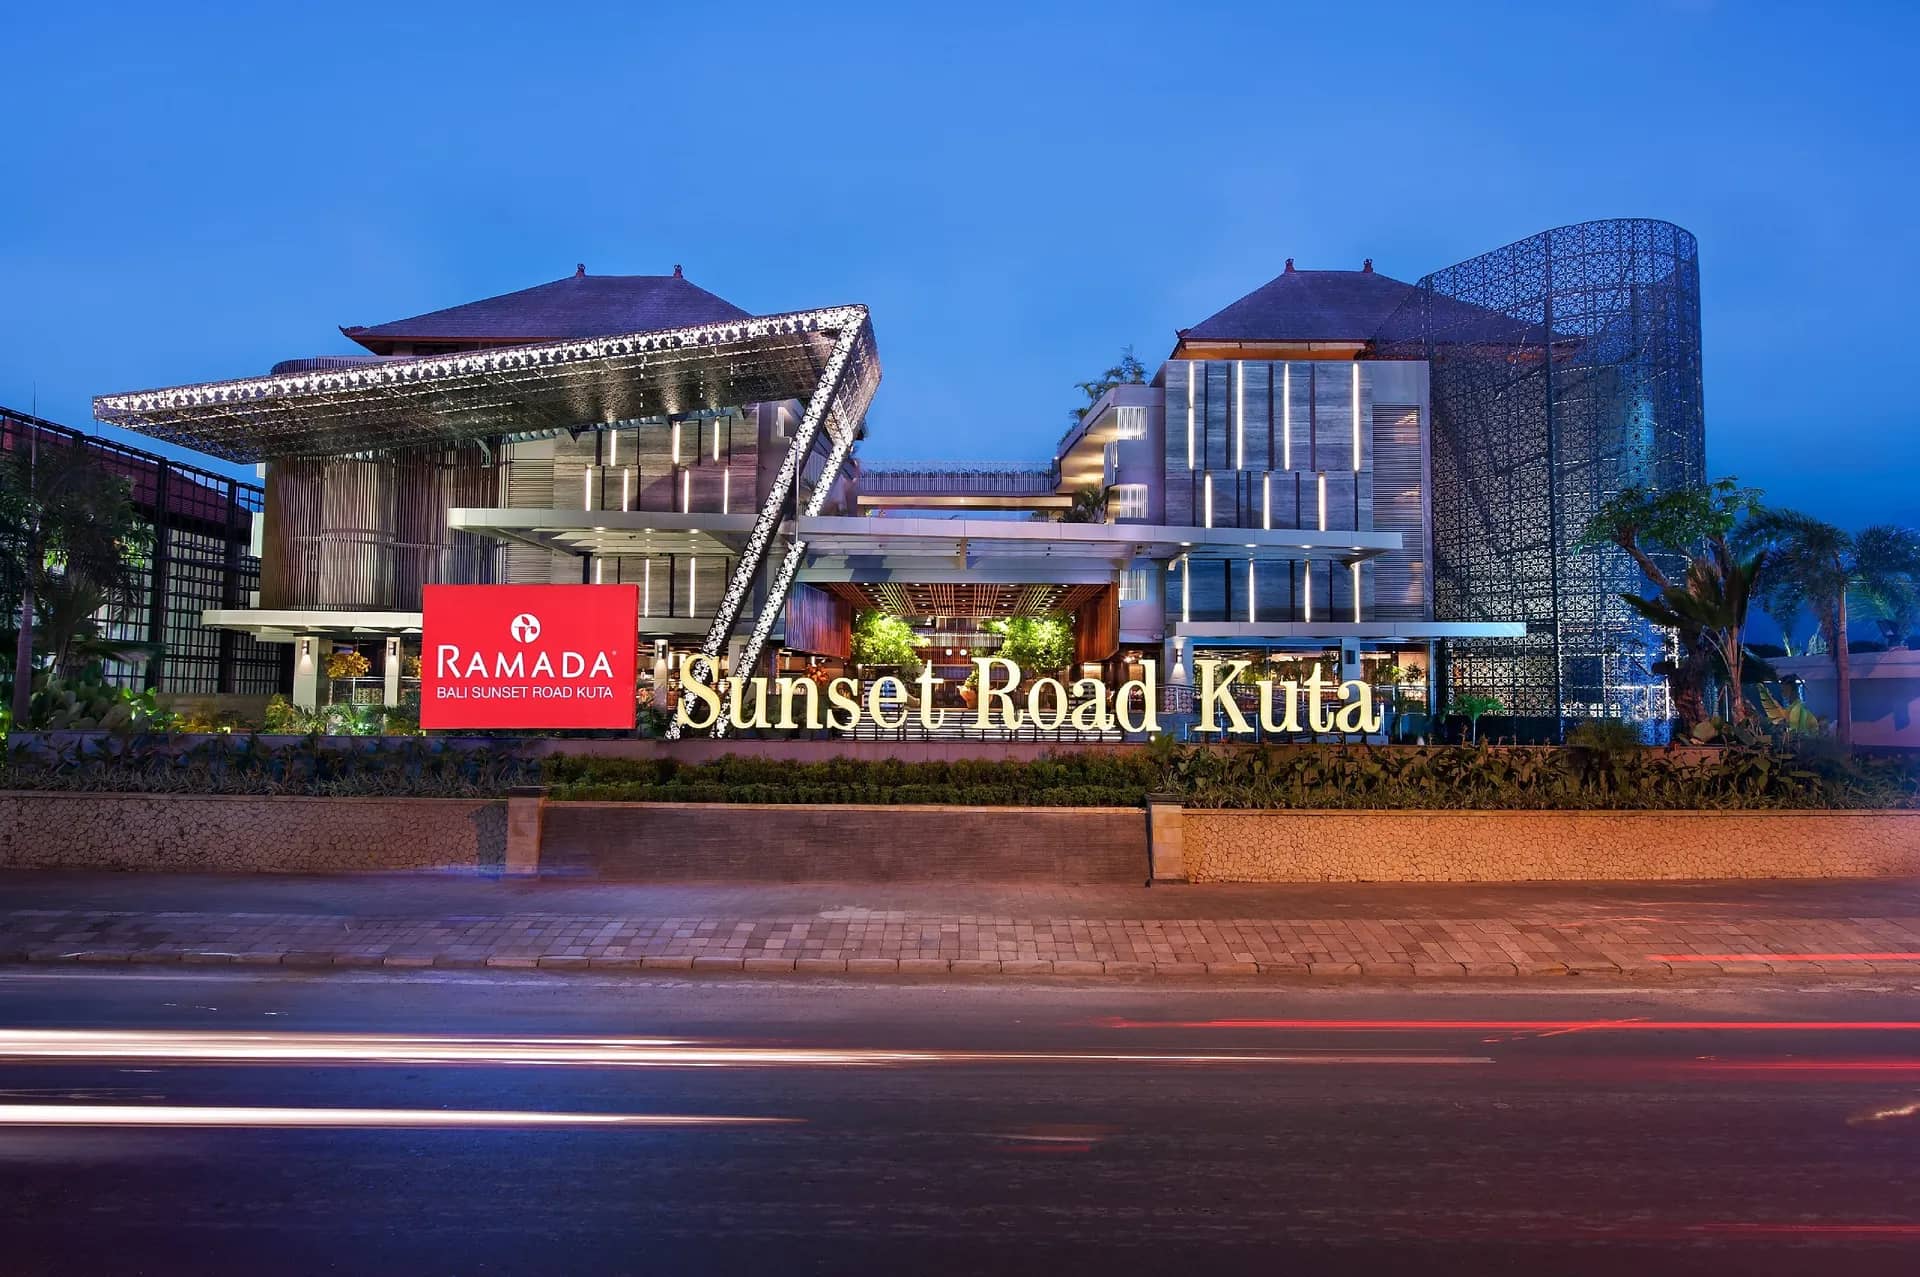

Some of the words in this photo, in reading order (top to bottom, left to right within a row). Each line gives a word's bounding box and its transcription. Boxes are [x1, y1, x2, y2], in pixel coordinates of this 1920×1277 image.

[436, 686, 468, 699] BALI
[471, 686, 529, 699] SUNSET
[532, 686, 573, 699] ROAD
[577, 686, 614, 699] KUTA
[677, 653, 944, 730] Sunset
[970, 657, 1162, 733] Road
[1194, 659, 1381, 734] Kuta
